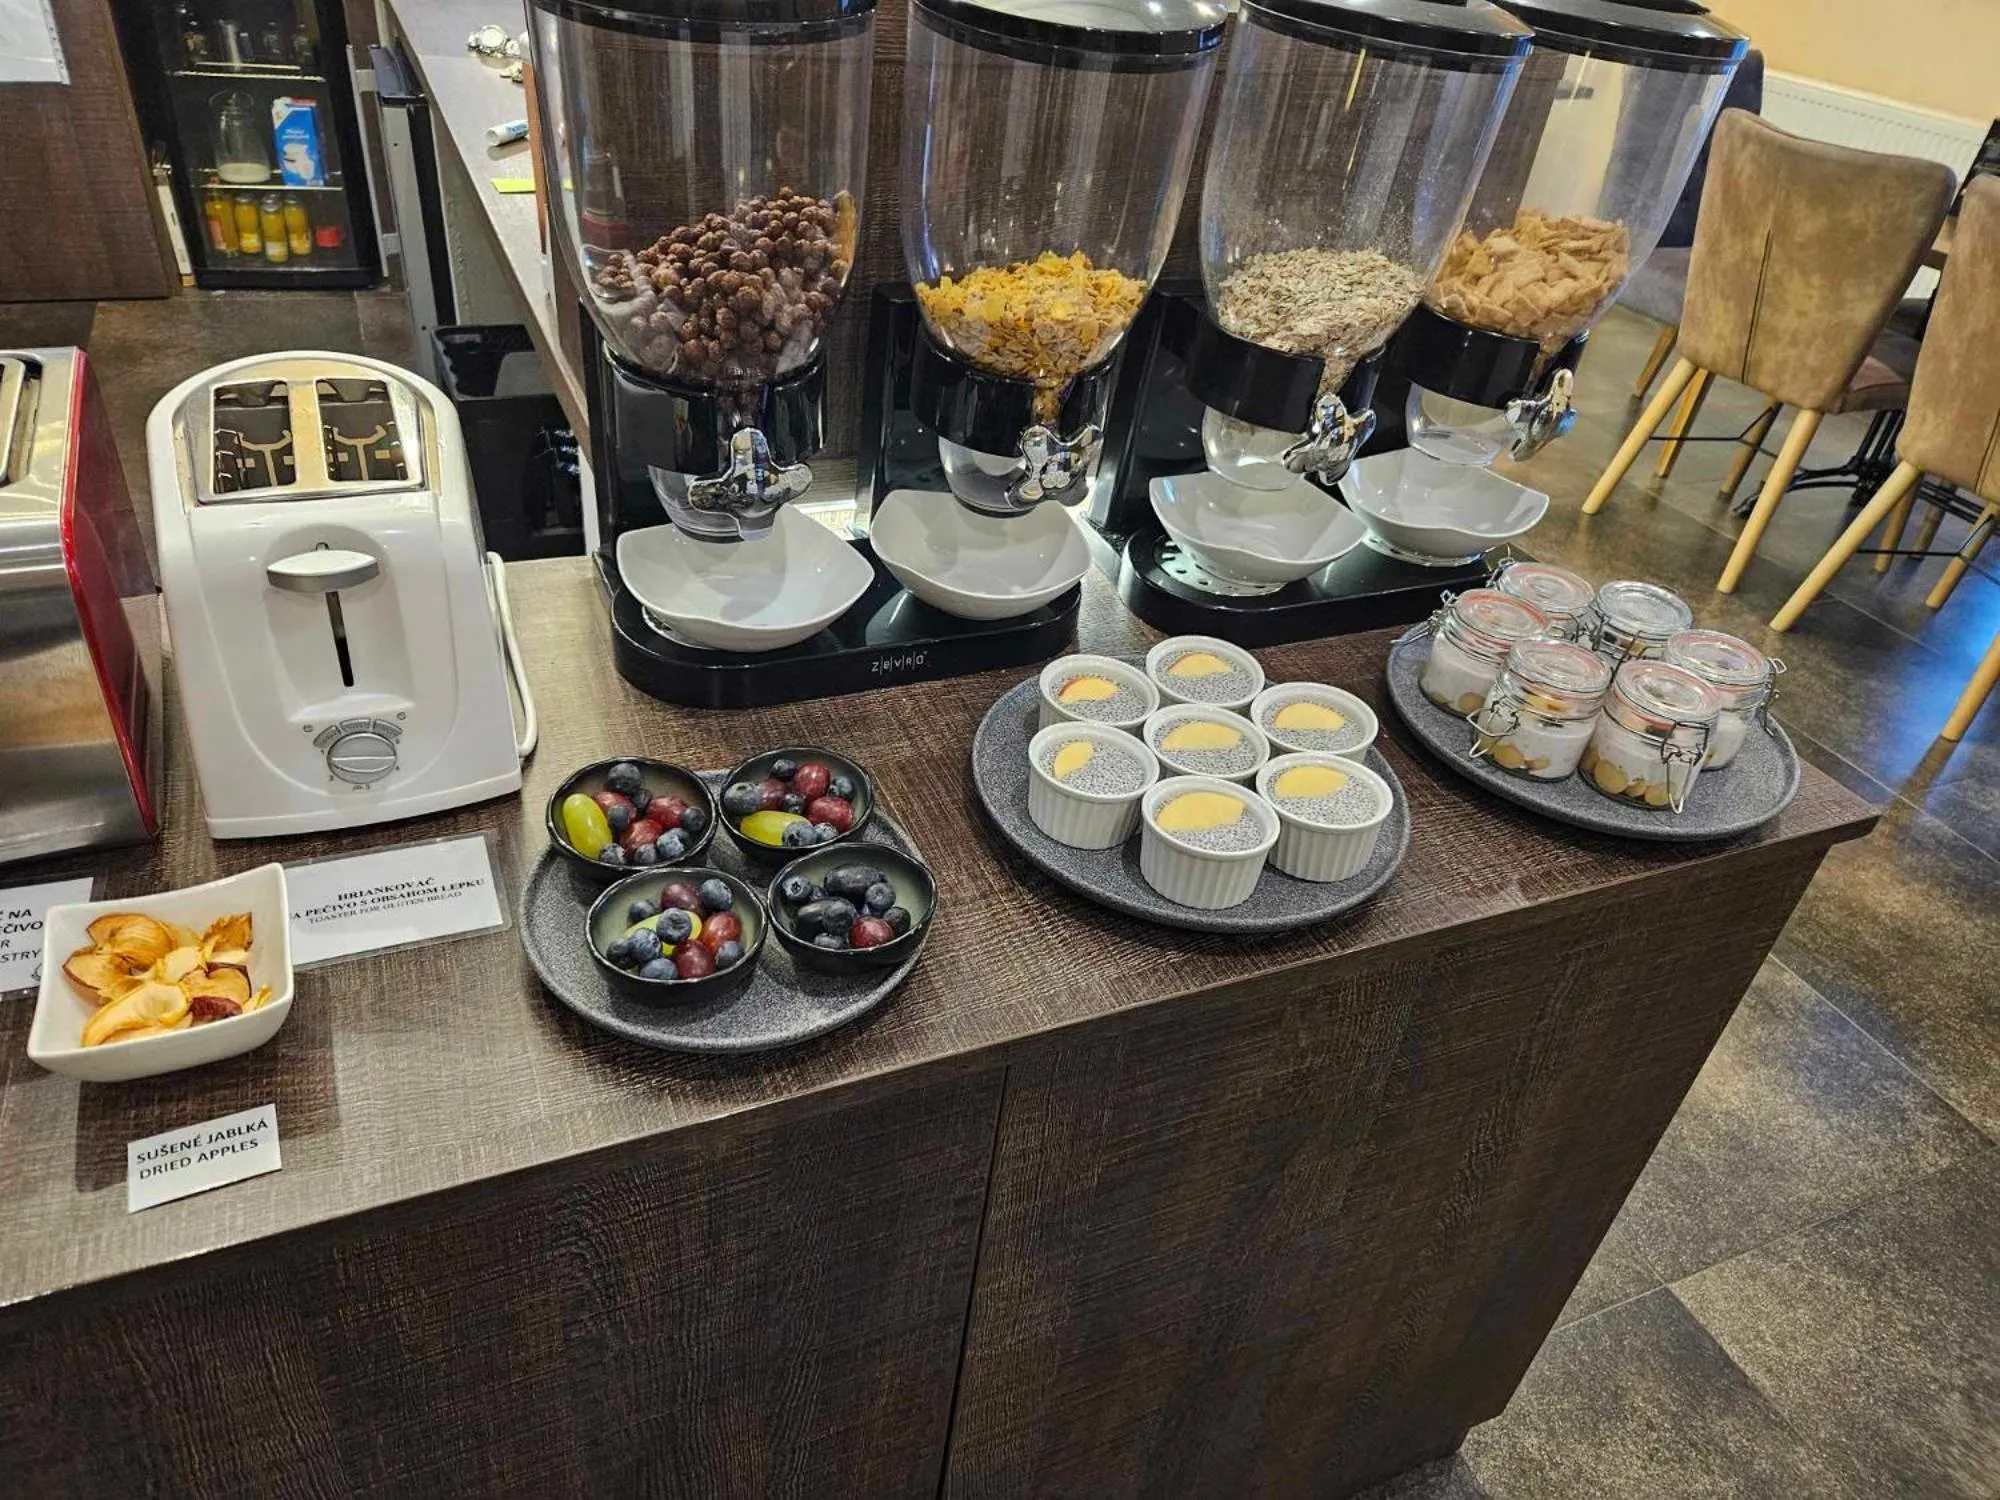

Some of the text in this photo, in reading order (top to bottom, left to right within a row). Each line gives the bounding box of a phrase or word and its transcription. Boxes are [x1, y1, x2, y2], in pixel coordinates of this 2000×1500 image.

[306, 901, 357, 917] PEČIVO
[371, 886, 438, 903] OBSAHOM
[441, 879, 485, 892] LEPKU
[8, 909, 32, 919] NA
[308, 910, 358, 924] TOASTER
[360, 905, 379, 914] FOR
[0, 921, 43, 934] ČIVO
[0, 949, 41, 963] STRY
[136, 1118, 268, 1164] SUŠENÉ JABLKÁ
[139, 1138, 259, 1180] DRIED APPLES
